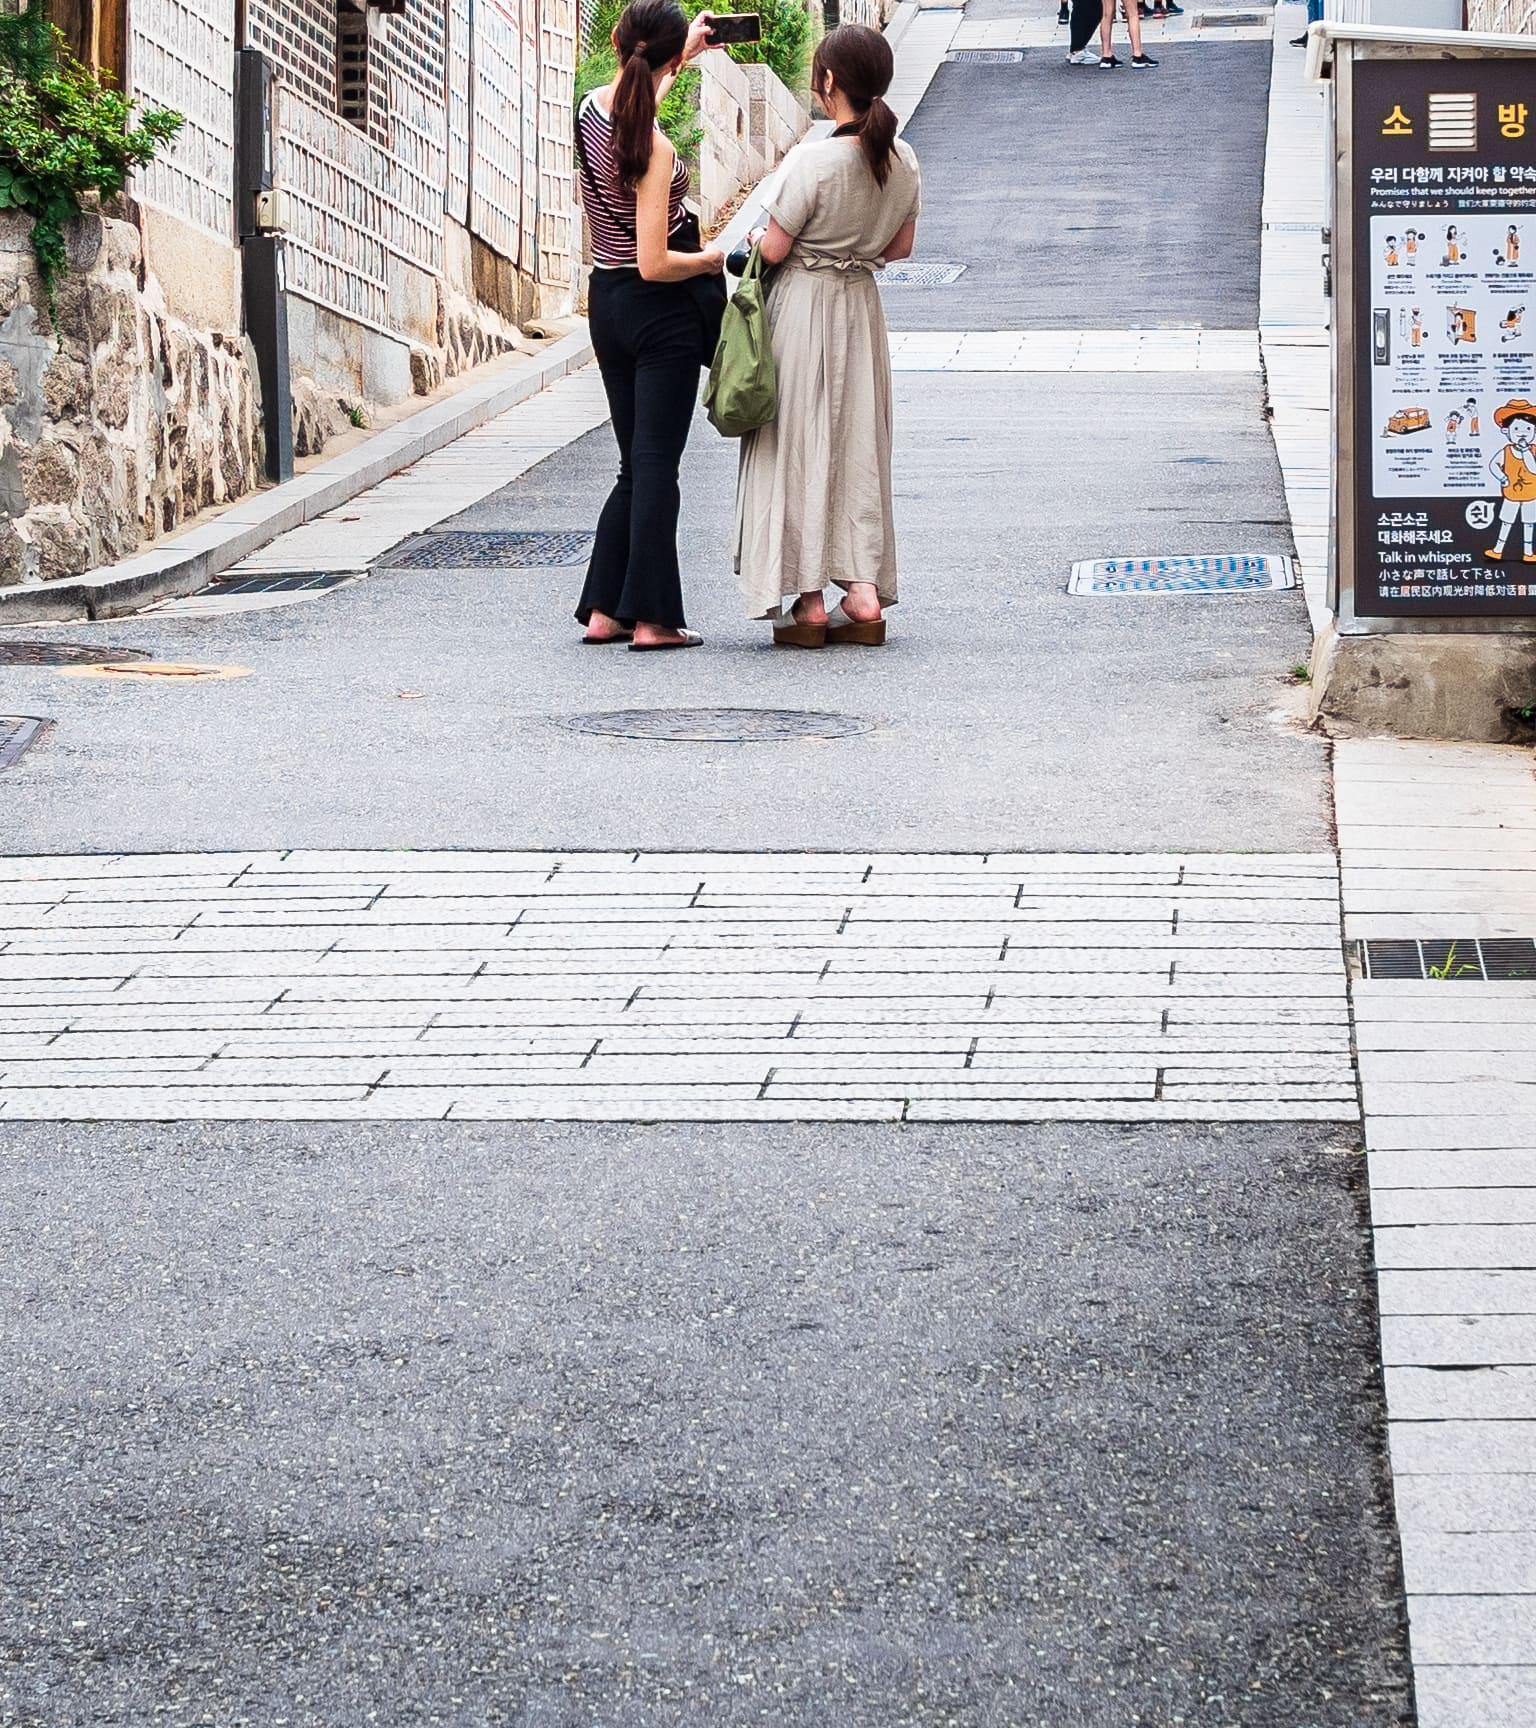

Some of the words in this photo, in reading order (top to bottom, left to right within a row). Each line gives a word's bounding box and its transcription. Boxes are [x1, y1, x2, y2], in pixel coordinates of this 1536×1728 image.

[1382, 105, 1413, 135] 소
[1498, 103, 1529, 138] 방
[1370, 167, 1398, 183] 우리
[1402, 166, 1444, 183] 다함께
[1447, 166, 1488, 183] 지켜야
[1492, 166, 1507, 182] 할
[1370, 187, 1409, 196] Promises
[1411, 187, 1429, 195] that
[1445, 186, 1475, 195] should
[1476, 186, 1498, 196] keep
[1499, 186, 1536, 196] together
[1377, 512, 1429, 527] 소곤소곤
[1470, 504, 1490, 524] 쉿
[1378, 530, 1454, 545] 대화해주세요
[1378, 551, 1403, 563] Talk
[1404, 551, 1416, 563] in
[1416, 551, 1472, 565] whispers
[1378, 568, 1506, 582] 小さな声で話して下さい
